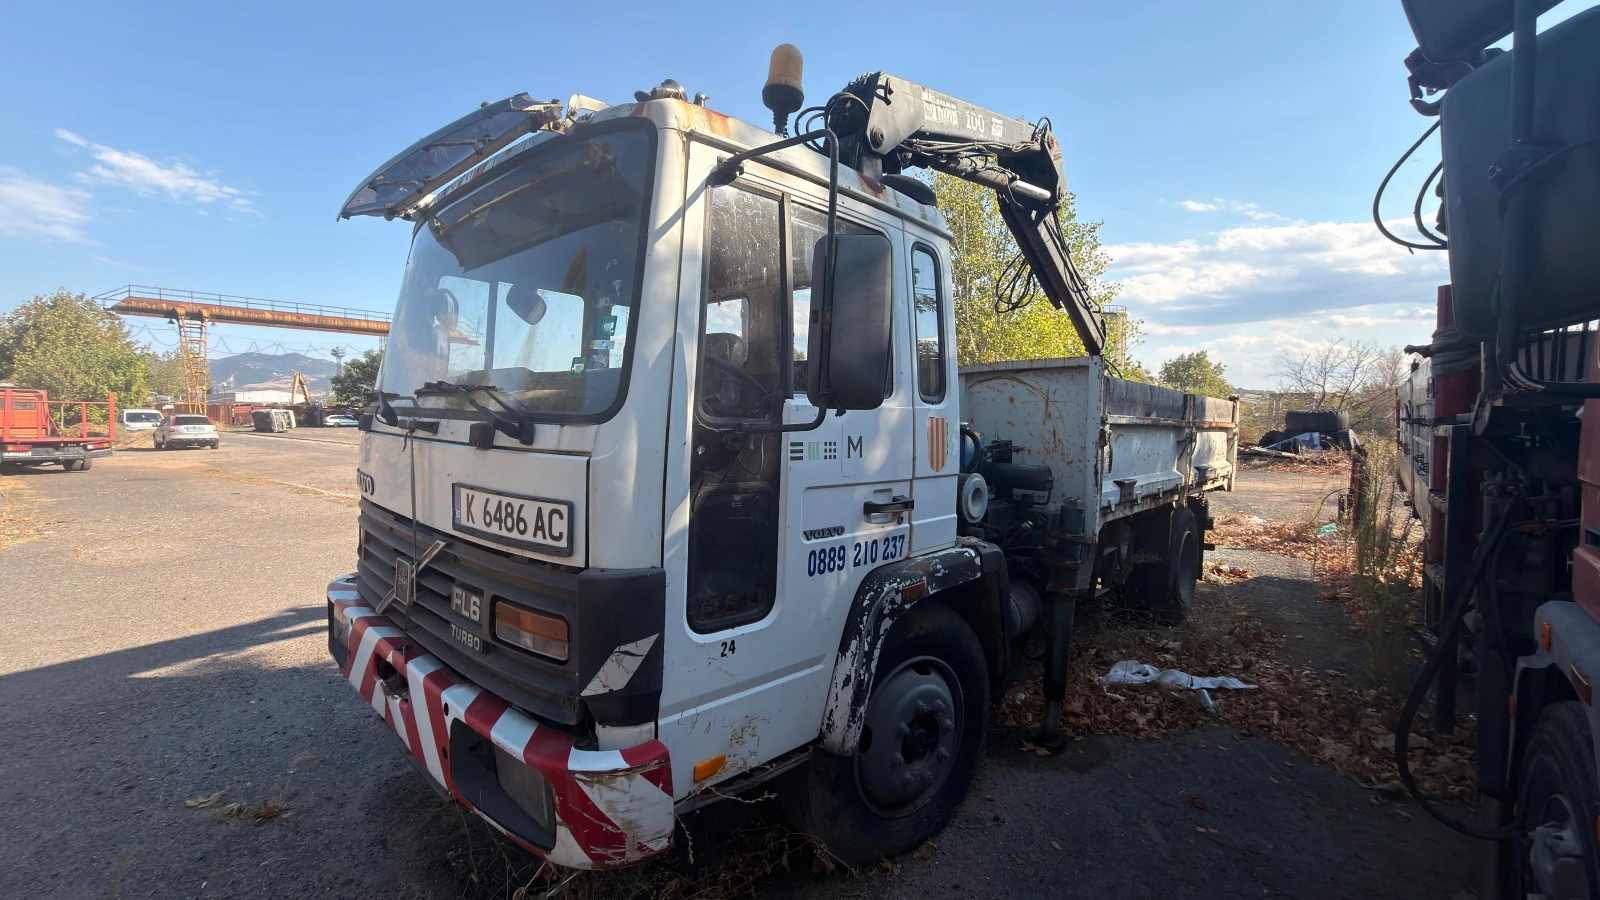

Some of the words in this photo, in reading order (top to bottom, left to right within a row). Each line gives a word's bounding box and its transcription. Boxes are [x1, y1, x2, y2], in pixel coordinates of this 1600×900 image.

[847, 435, 863, 459] M
[466, 493, 475, 524] K
[483, 498, 528, 536] 6486
[533, 506, 564, 542] AC
[803, 525, 845, 541] VOLVO
[808, 545, 846, 577] 0889
[853, 539, 878, 568] 210
[883, 533, 905, 561] 237
[453, 586, 481, 622] FL6
[451, 623, 480, 651] TURBO
[721, 639, 736, 658] 24
